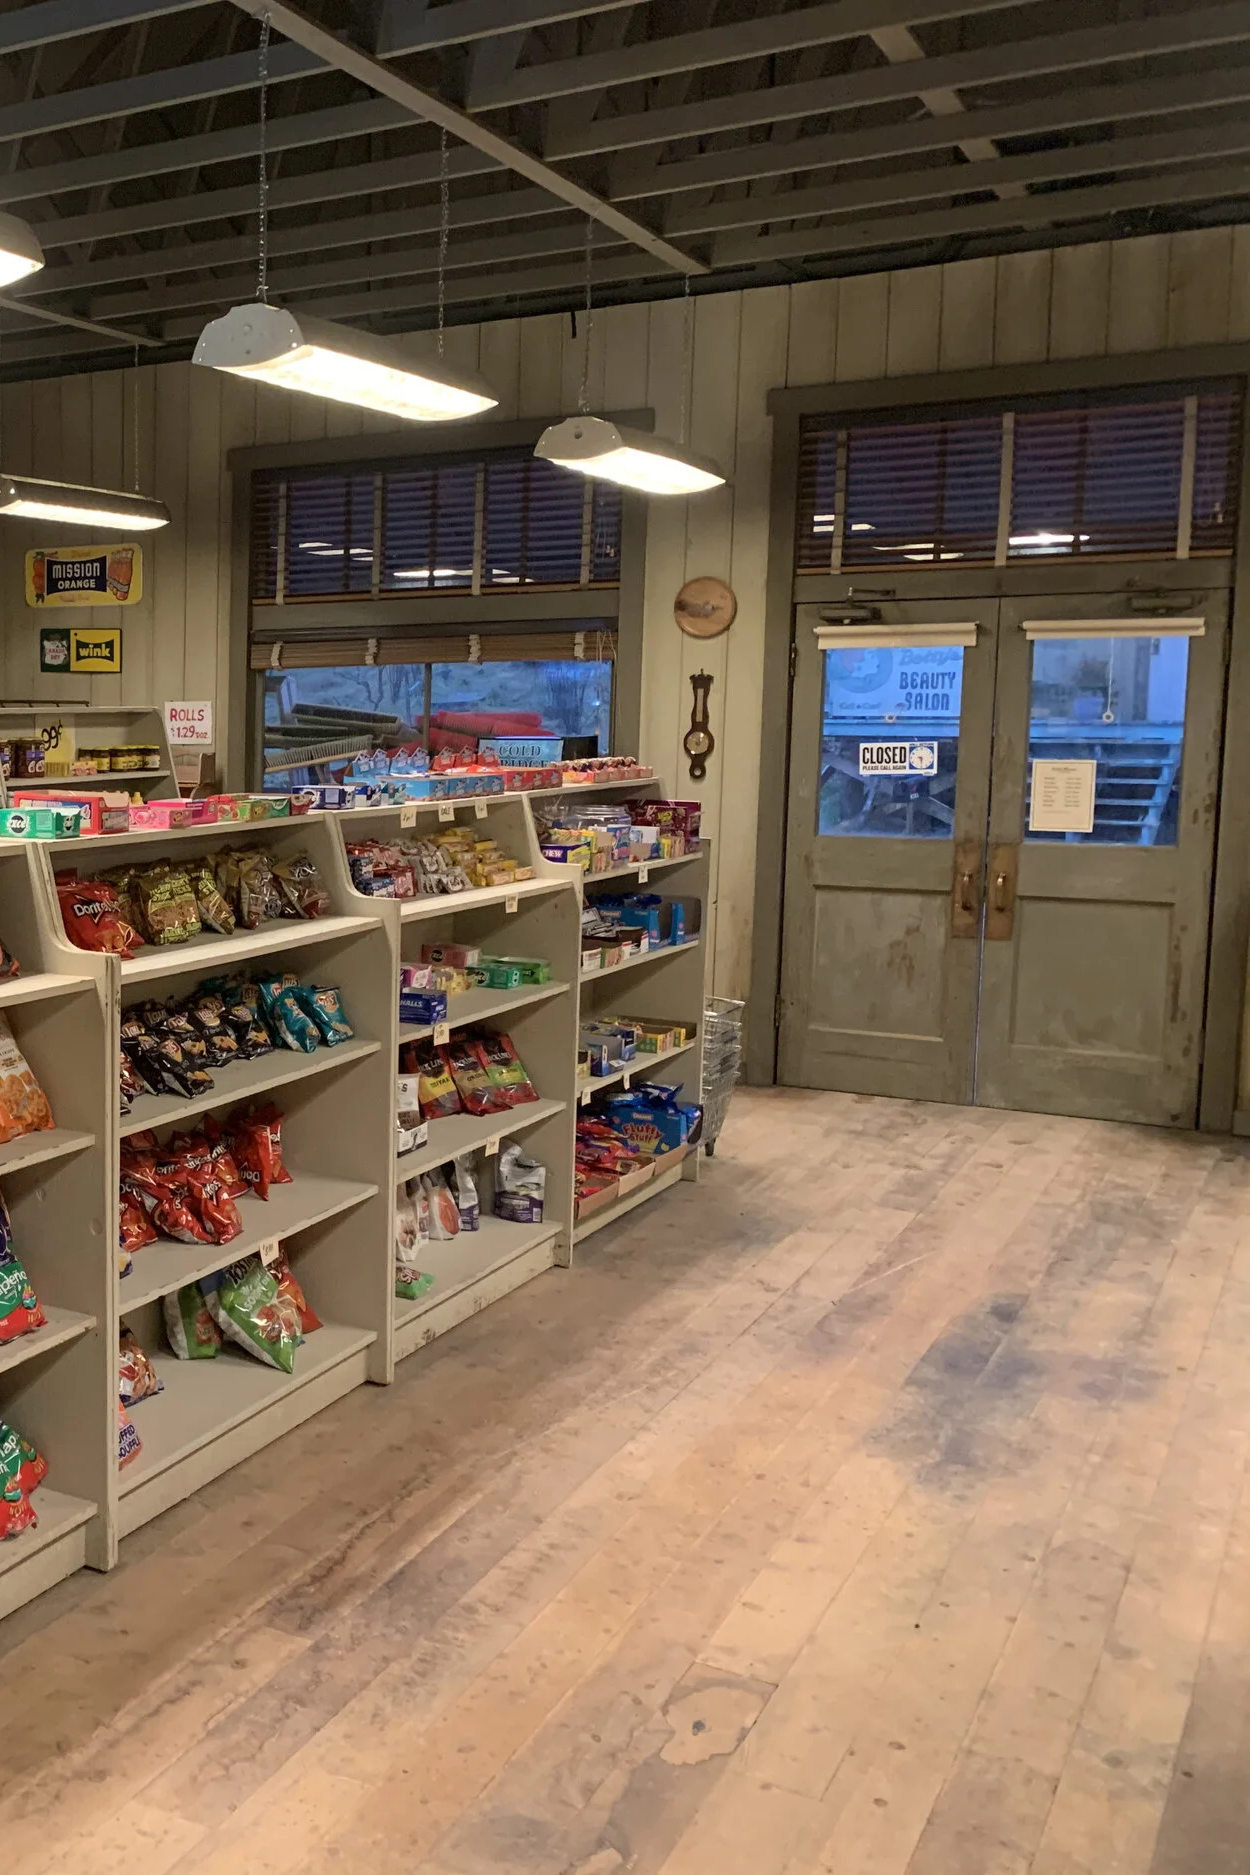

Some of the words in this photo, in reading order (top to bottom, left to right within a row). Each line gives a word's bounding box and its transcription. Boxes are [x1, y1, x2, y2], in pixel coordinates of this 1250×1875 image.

[57, 579, 96, 590] ORANGE
[78, 644, 111, 657] wink
[899, 671, 956, 690] BEAUTY
[904, 692, 950, 711] SALON
[169, 707, 205, 722] ROLLS
[499, 745, 541, 757] COLD
[862, 746, 907, 764] CLOSED
